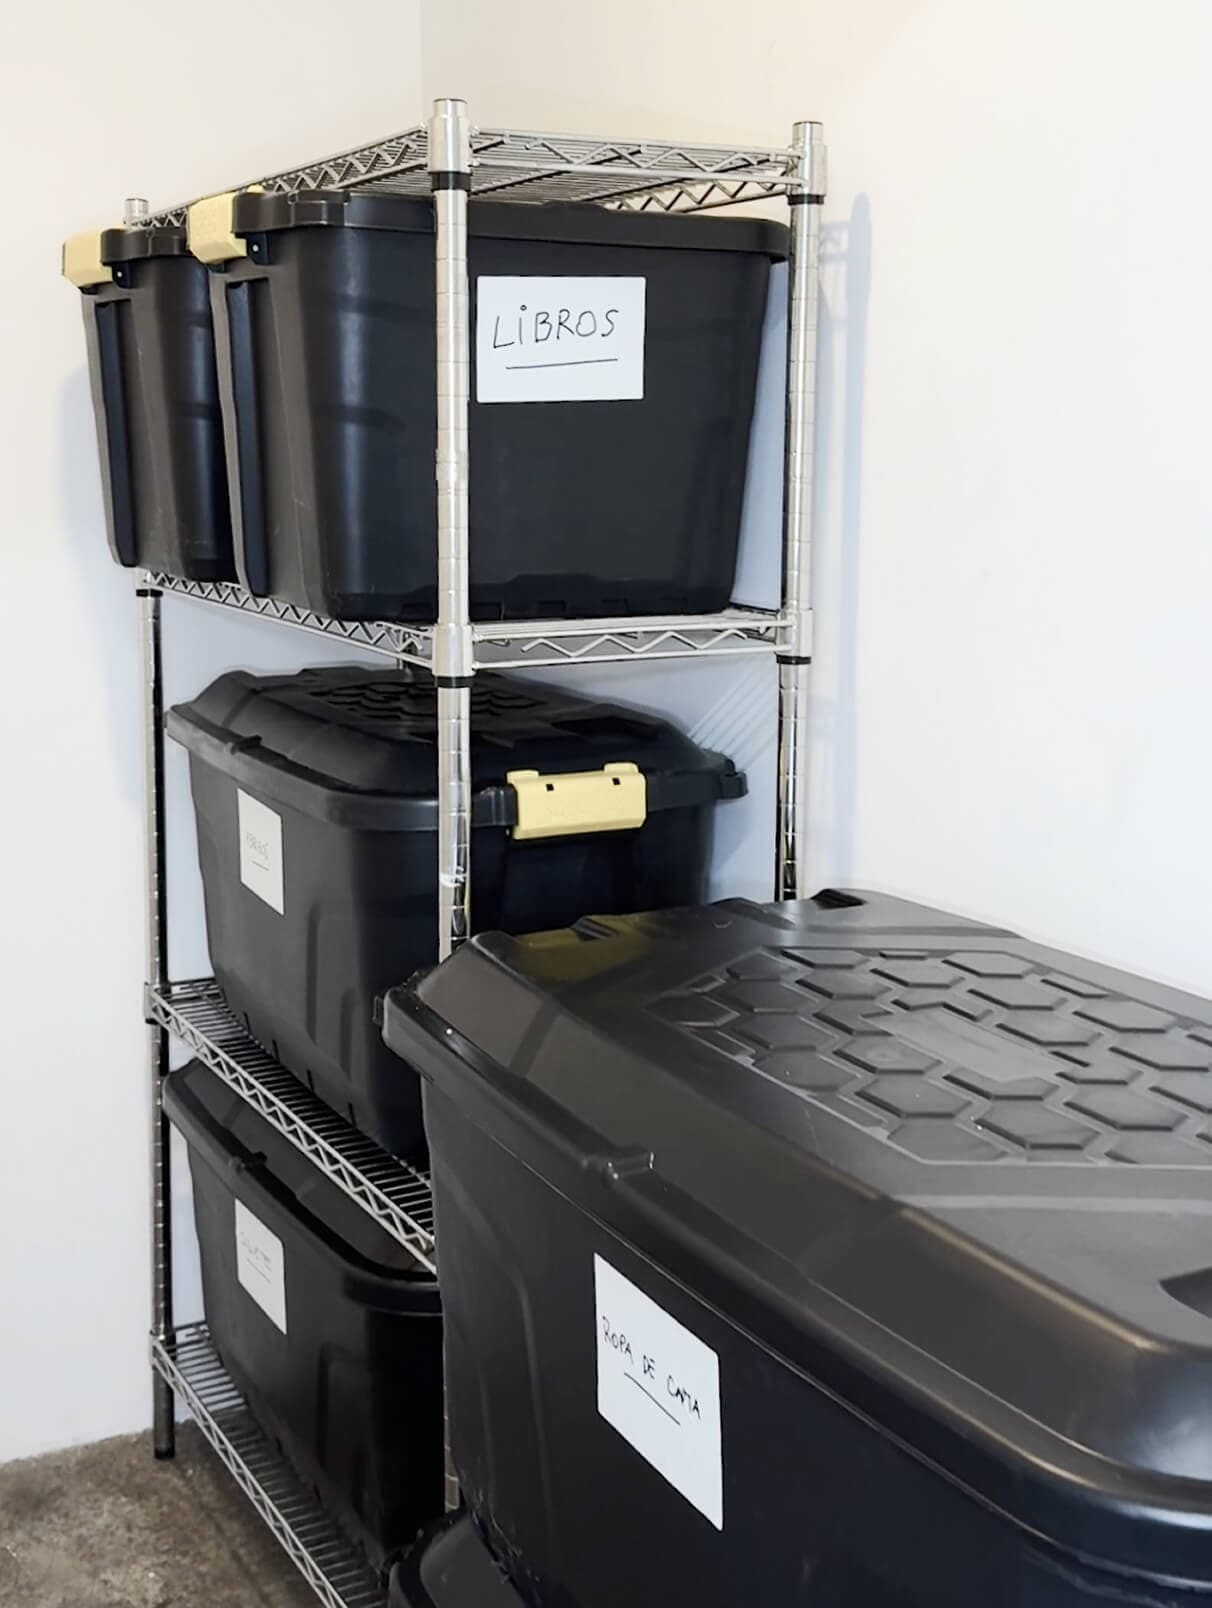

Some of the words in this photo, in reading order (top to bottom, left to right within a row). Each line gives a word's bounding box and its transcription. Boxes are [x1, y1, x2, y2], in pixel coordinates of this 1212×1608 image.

[602, 1315, 634, 1365] ROPA
[642, 1354, 656, 1380] DE
[667, 1374, 701, 1420] CAMA
